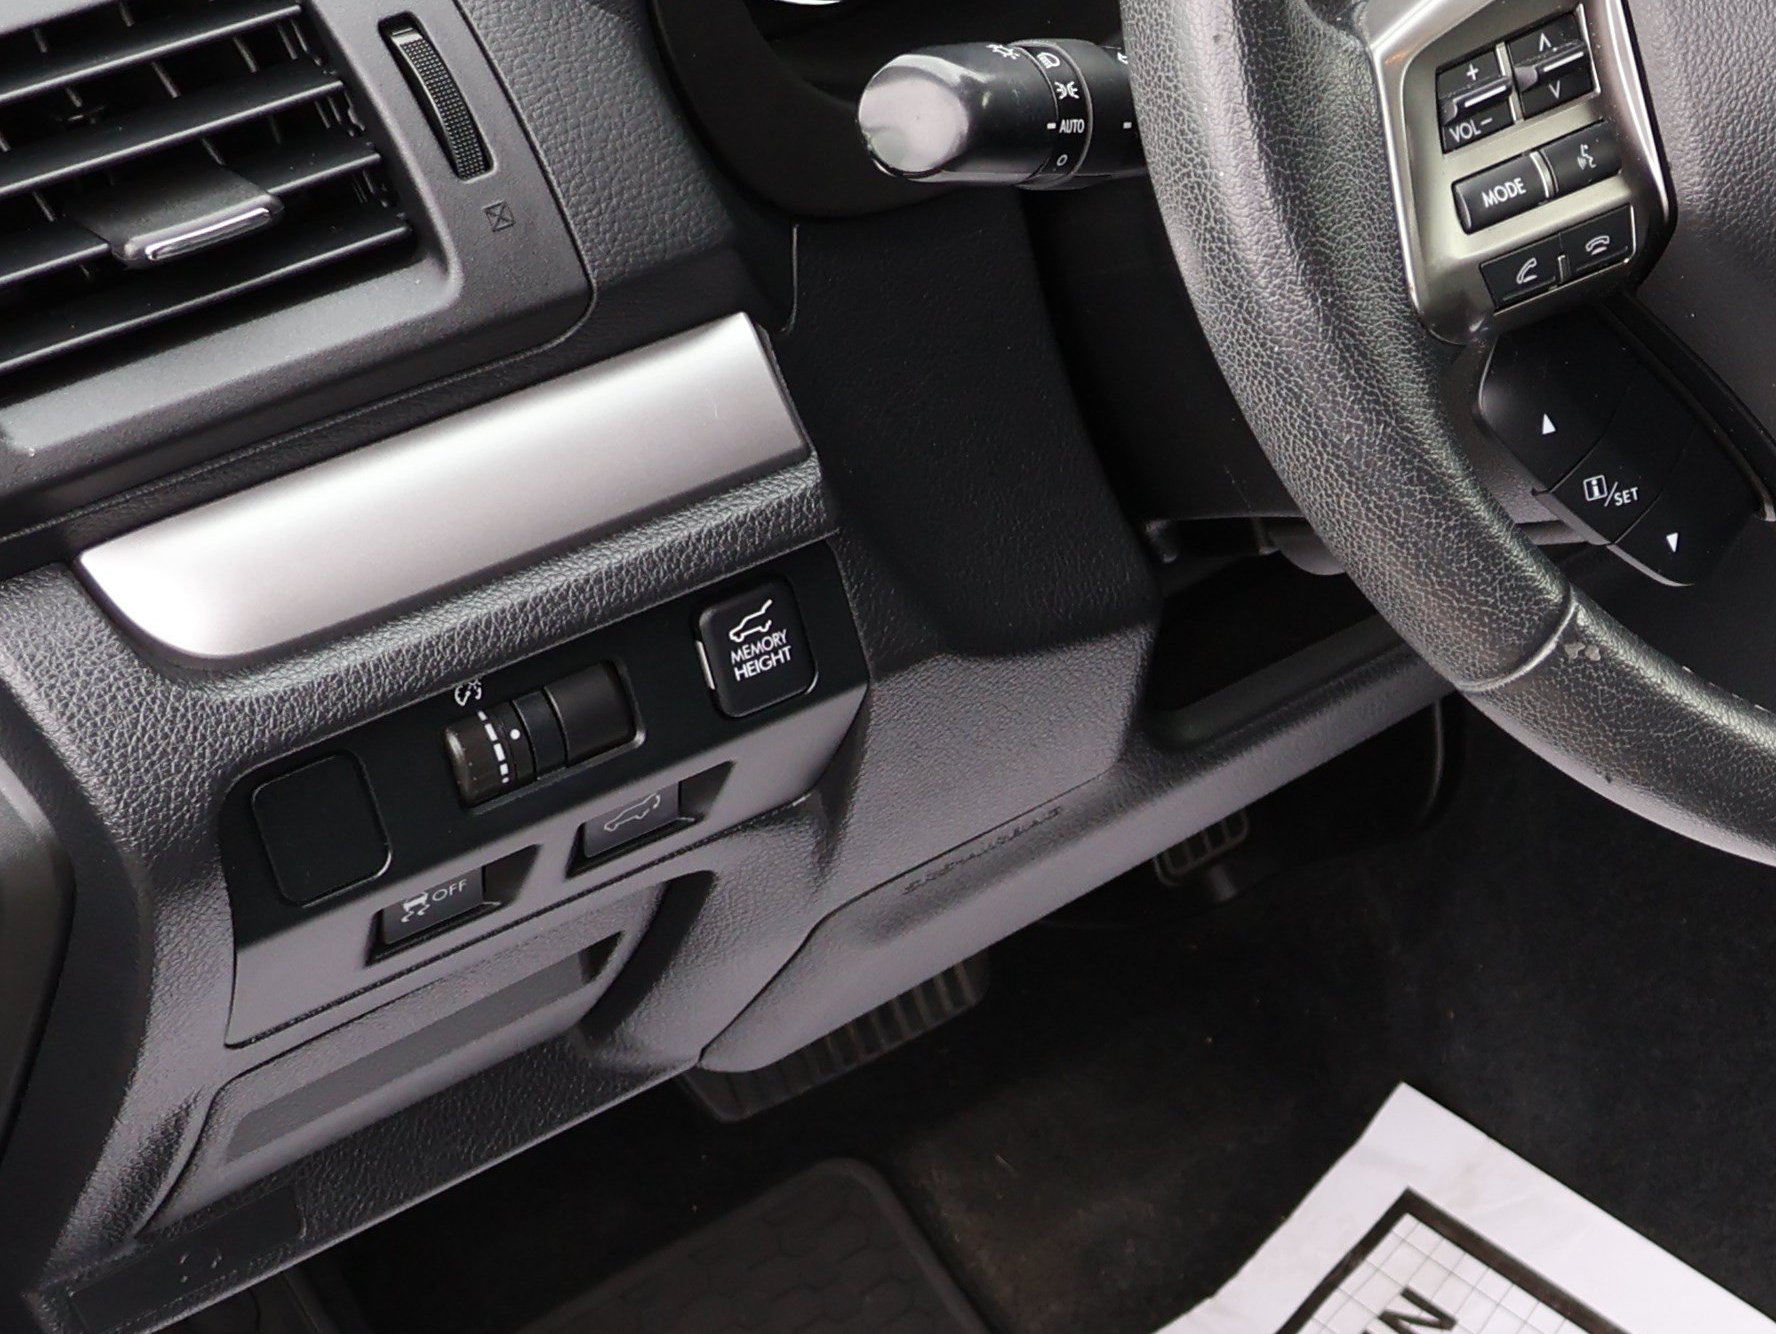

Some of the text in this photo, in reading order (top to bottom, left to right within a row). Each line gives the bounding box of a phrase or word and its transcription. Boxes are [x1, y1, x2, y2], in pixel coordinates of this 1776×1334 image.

[1059, 116, 1085, 134] AUTO
[1480, 175, 1527, 208] MODE
[730, 628, 788, 667] MEMORY
[734, 644, 793, 683] HEIGHT
[432, 878, 468, 903] OFF
